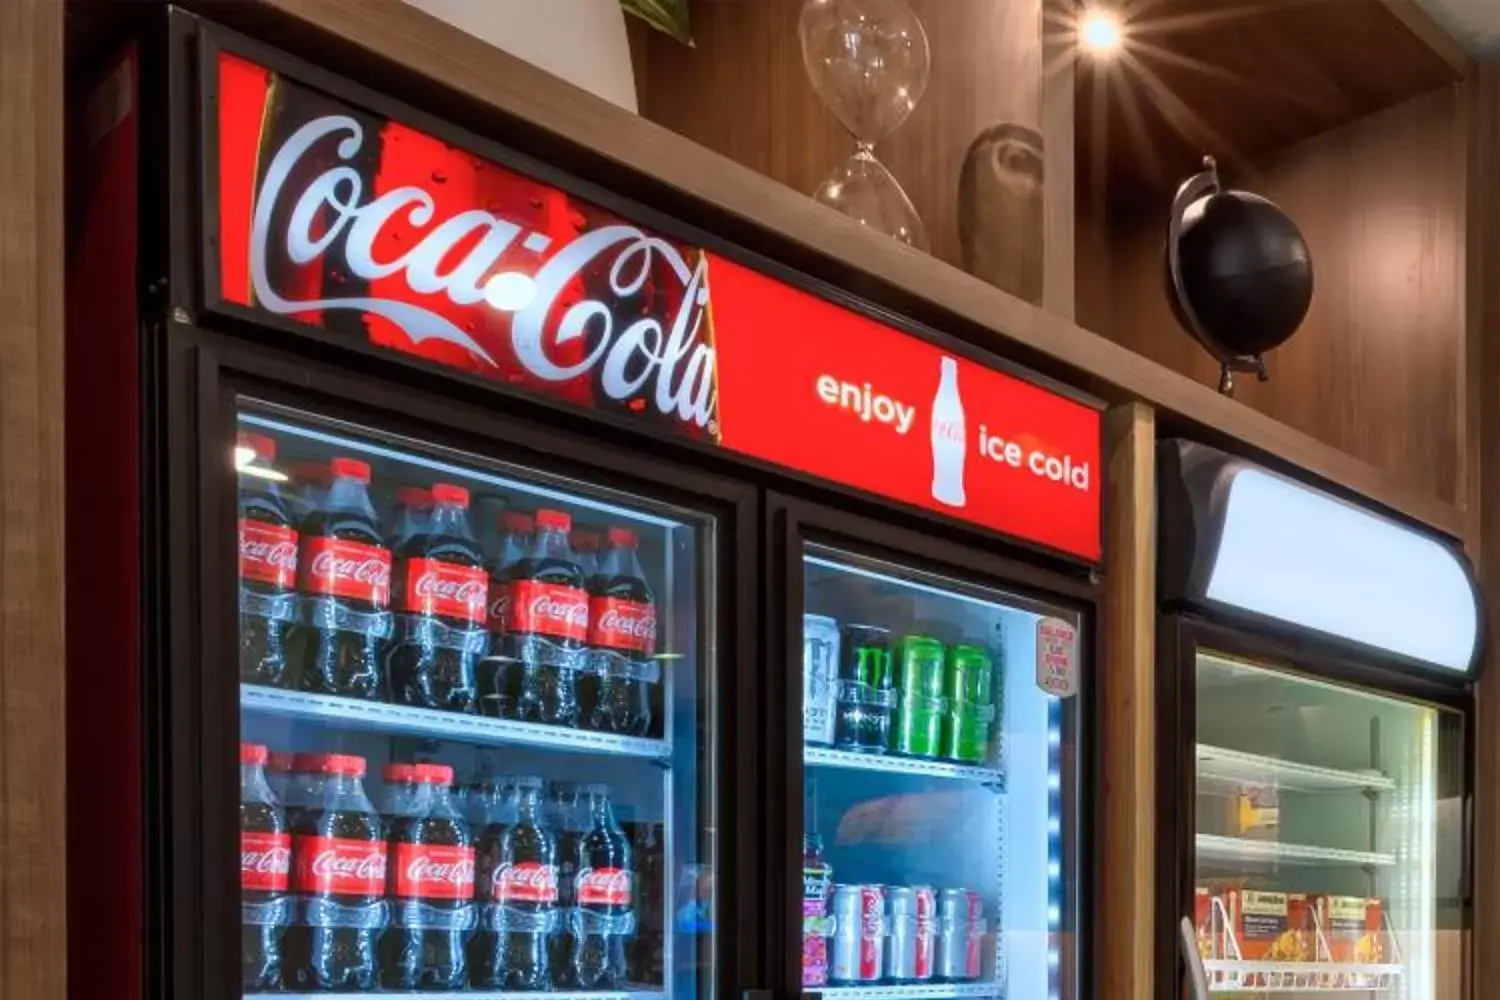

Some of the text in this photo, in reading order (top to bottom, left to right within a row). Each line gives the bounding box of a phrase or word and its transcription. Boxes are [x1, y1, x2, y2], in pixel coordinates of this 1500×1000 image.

[250, 114, 720, 432] Coca-Cola
[816, 373, 916, 433] enjoy
[979, 424, 1022, 468] ice
[1028, 451, 1090, 491] cold
[240, 541, 297, 570] oca-Cola
[312, 551, 391, 586] Coca-Cola
[415, 571, 487, 607] Coca-Cola
[312, 850, 386, 879] Coca-Cola
[407, 857, 475, 883] Coca-Cola
[493, 862, 560, 886] Coca-Cola
